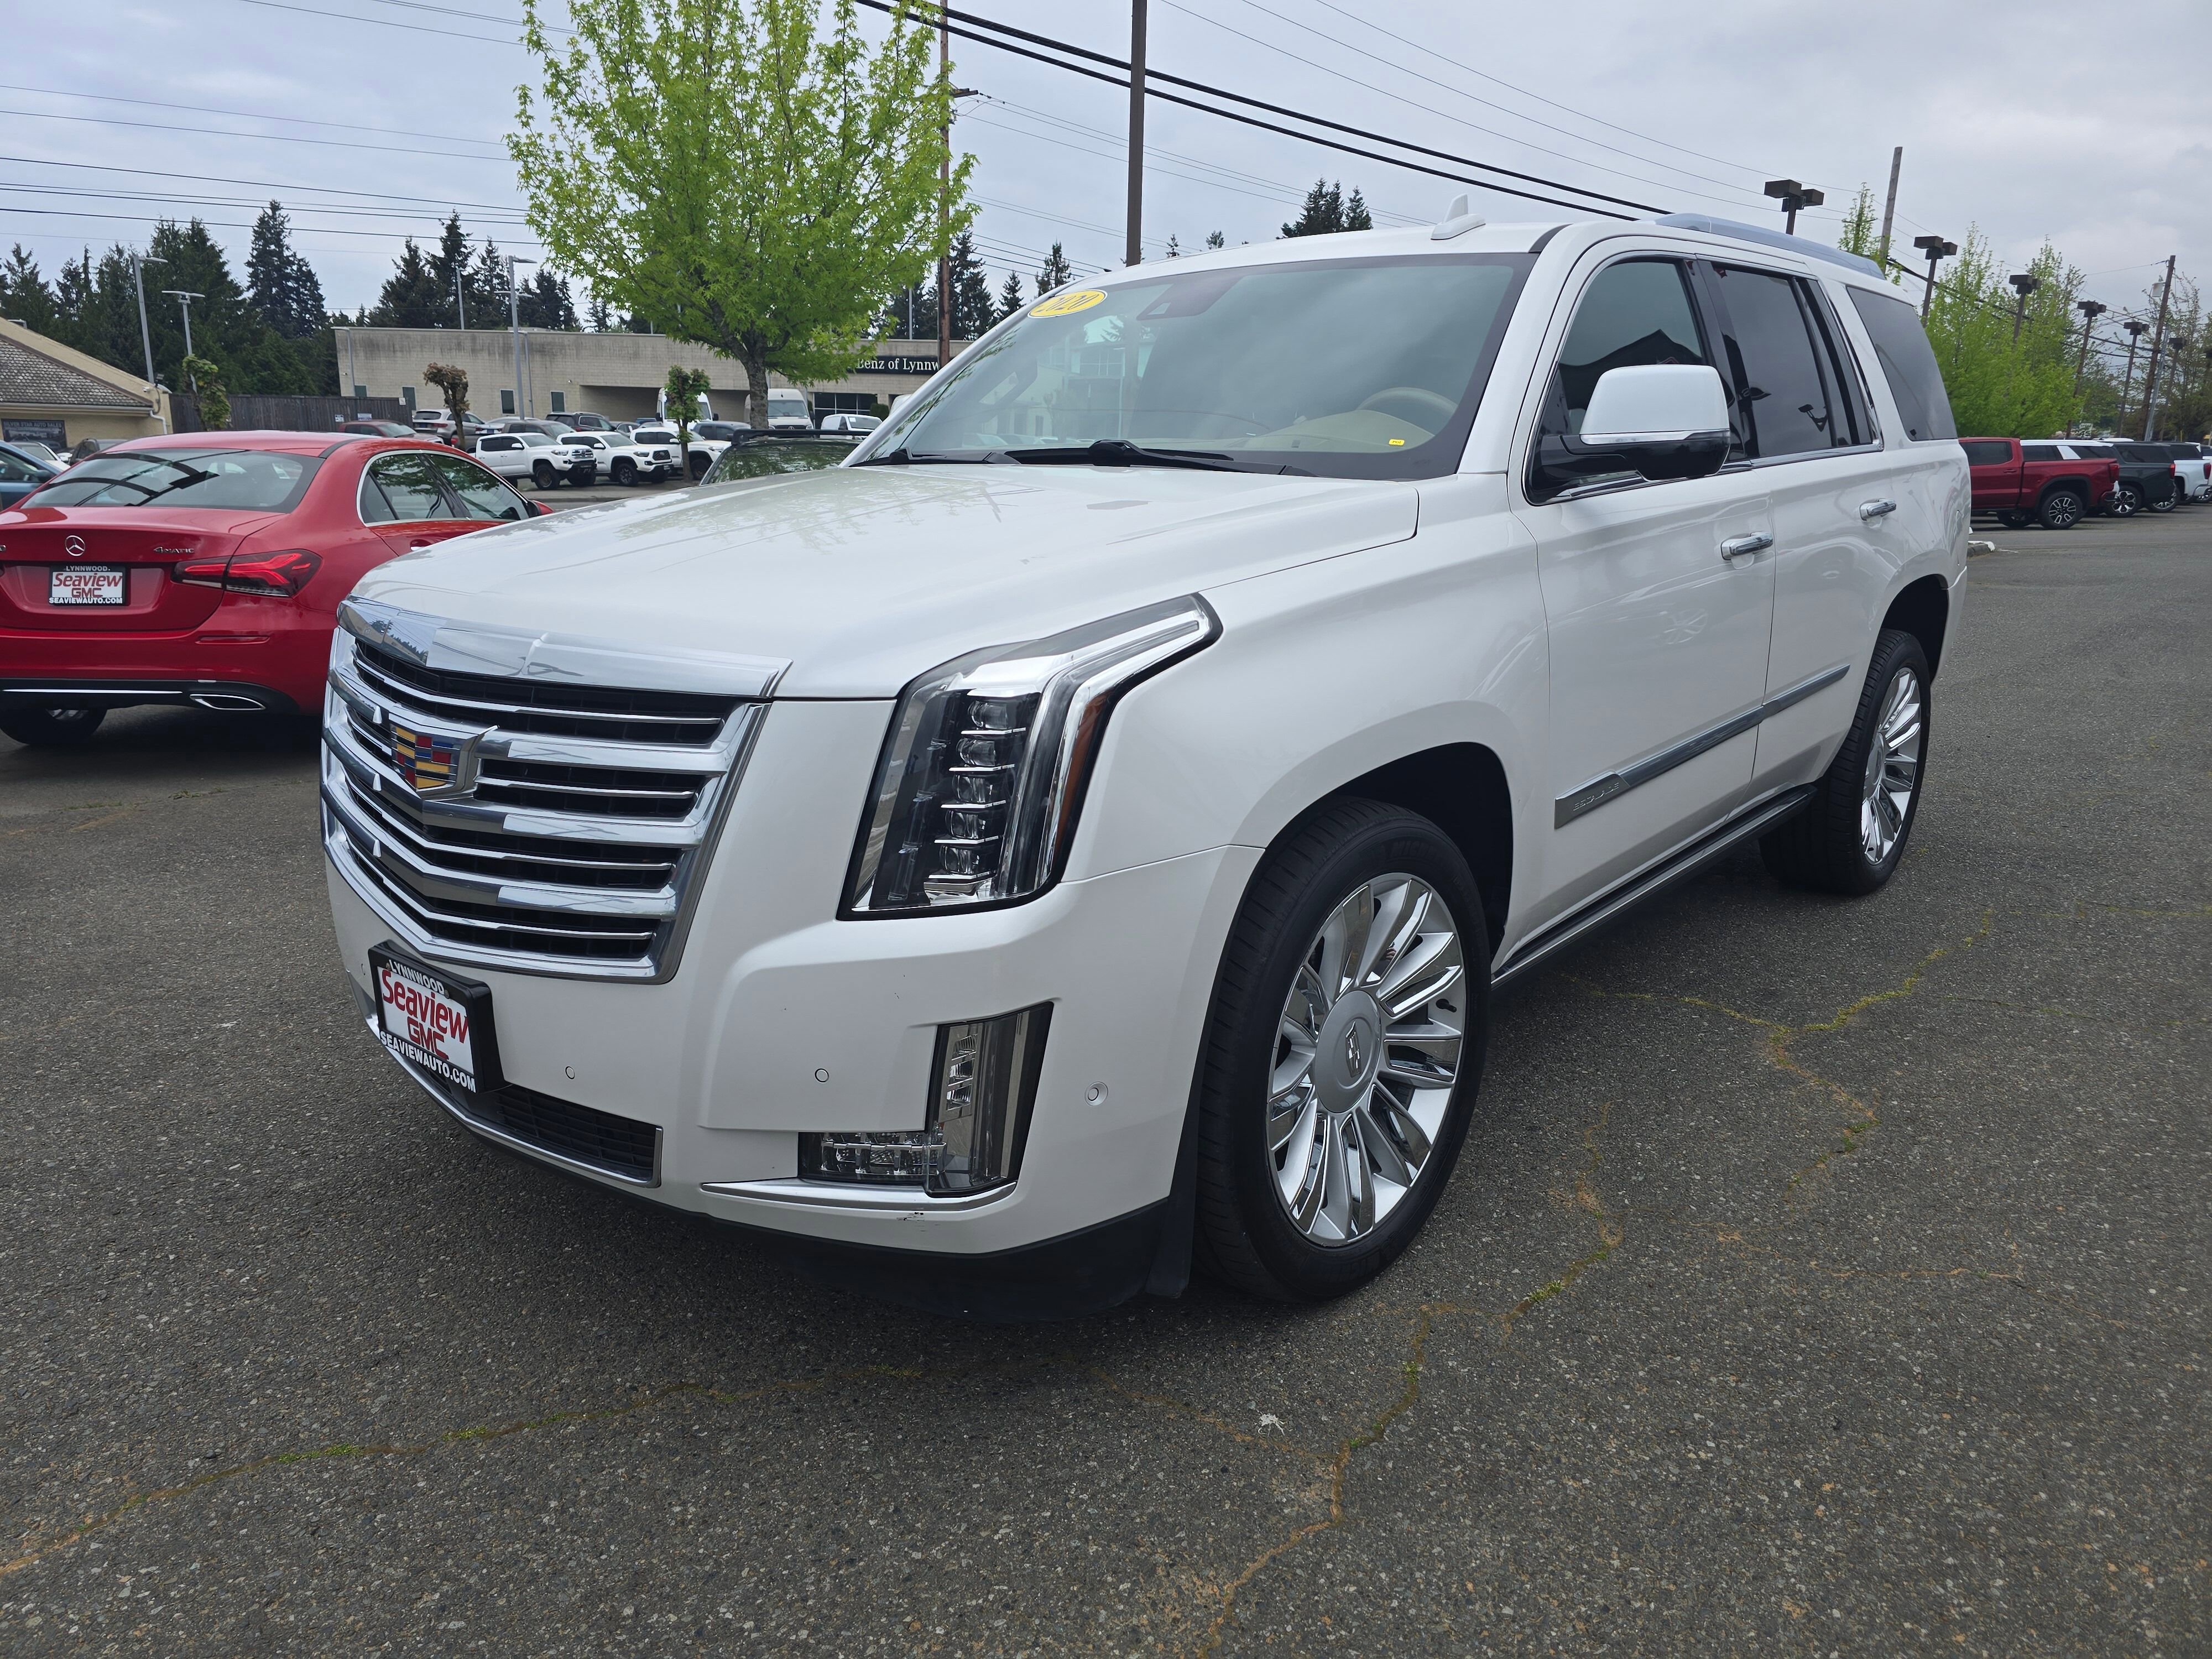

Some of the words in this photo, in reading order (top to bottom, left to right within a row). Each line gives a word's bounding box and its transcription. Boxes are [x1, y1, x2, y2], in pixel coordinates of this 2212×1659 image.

[858, 359, 885, 369] Benz
[888, 358, 900, 370] of
[53, 572, 122, 587] Seaview
[71, 587, 103, 598] GMC
[389, 959, 445, 995] LYNNWOOD
[382, 969, 469, 1044] Seaview
[406, 1016, 449, 1061] GMC
[379, 1031, 476, 1093] SEAVIEWAUTO.COM
